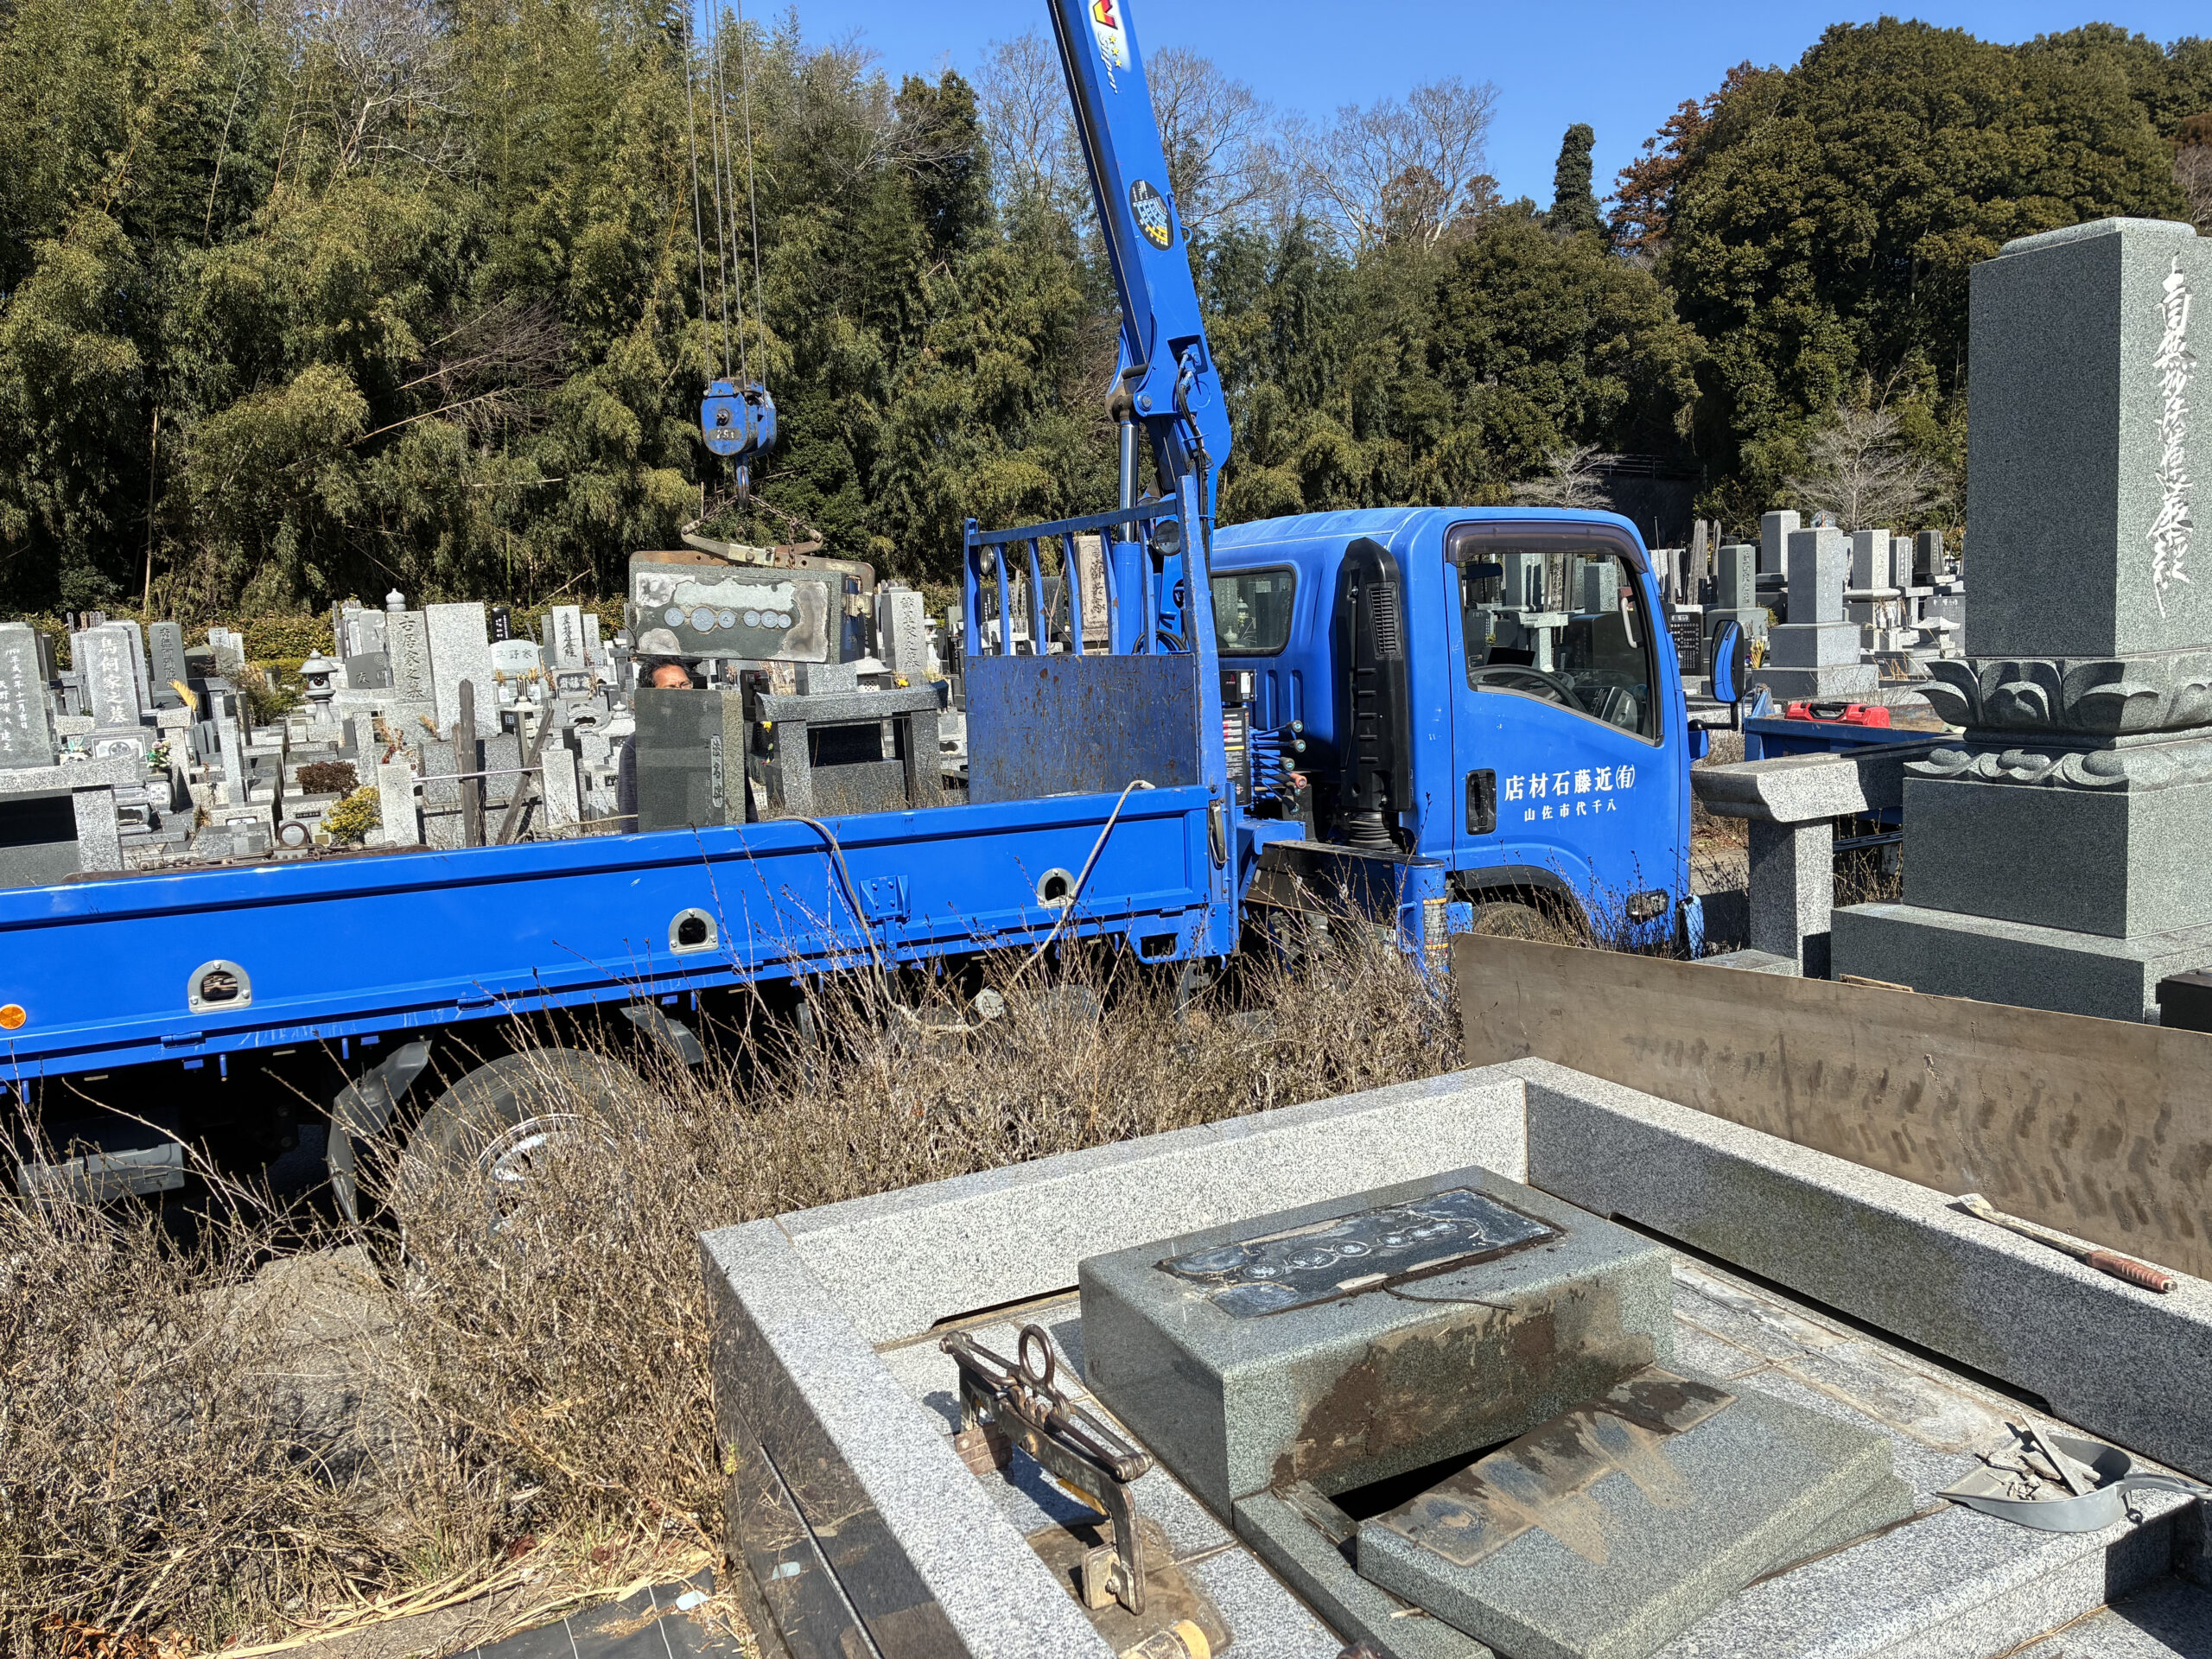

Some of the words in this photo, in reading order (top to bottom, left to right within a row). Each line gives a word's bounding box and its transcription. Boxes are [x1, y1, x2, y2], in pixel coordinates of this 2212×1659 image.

[1097, 32, 1118, 95] Super
[99, 636, 130, 723] 鳥飼家之墓
